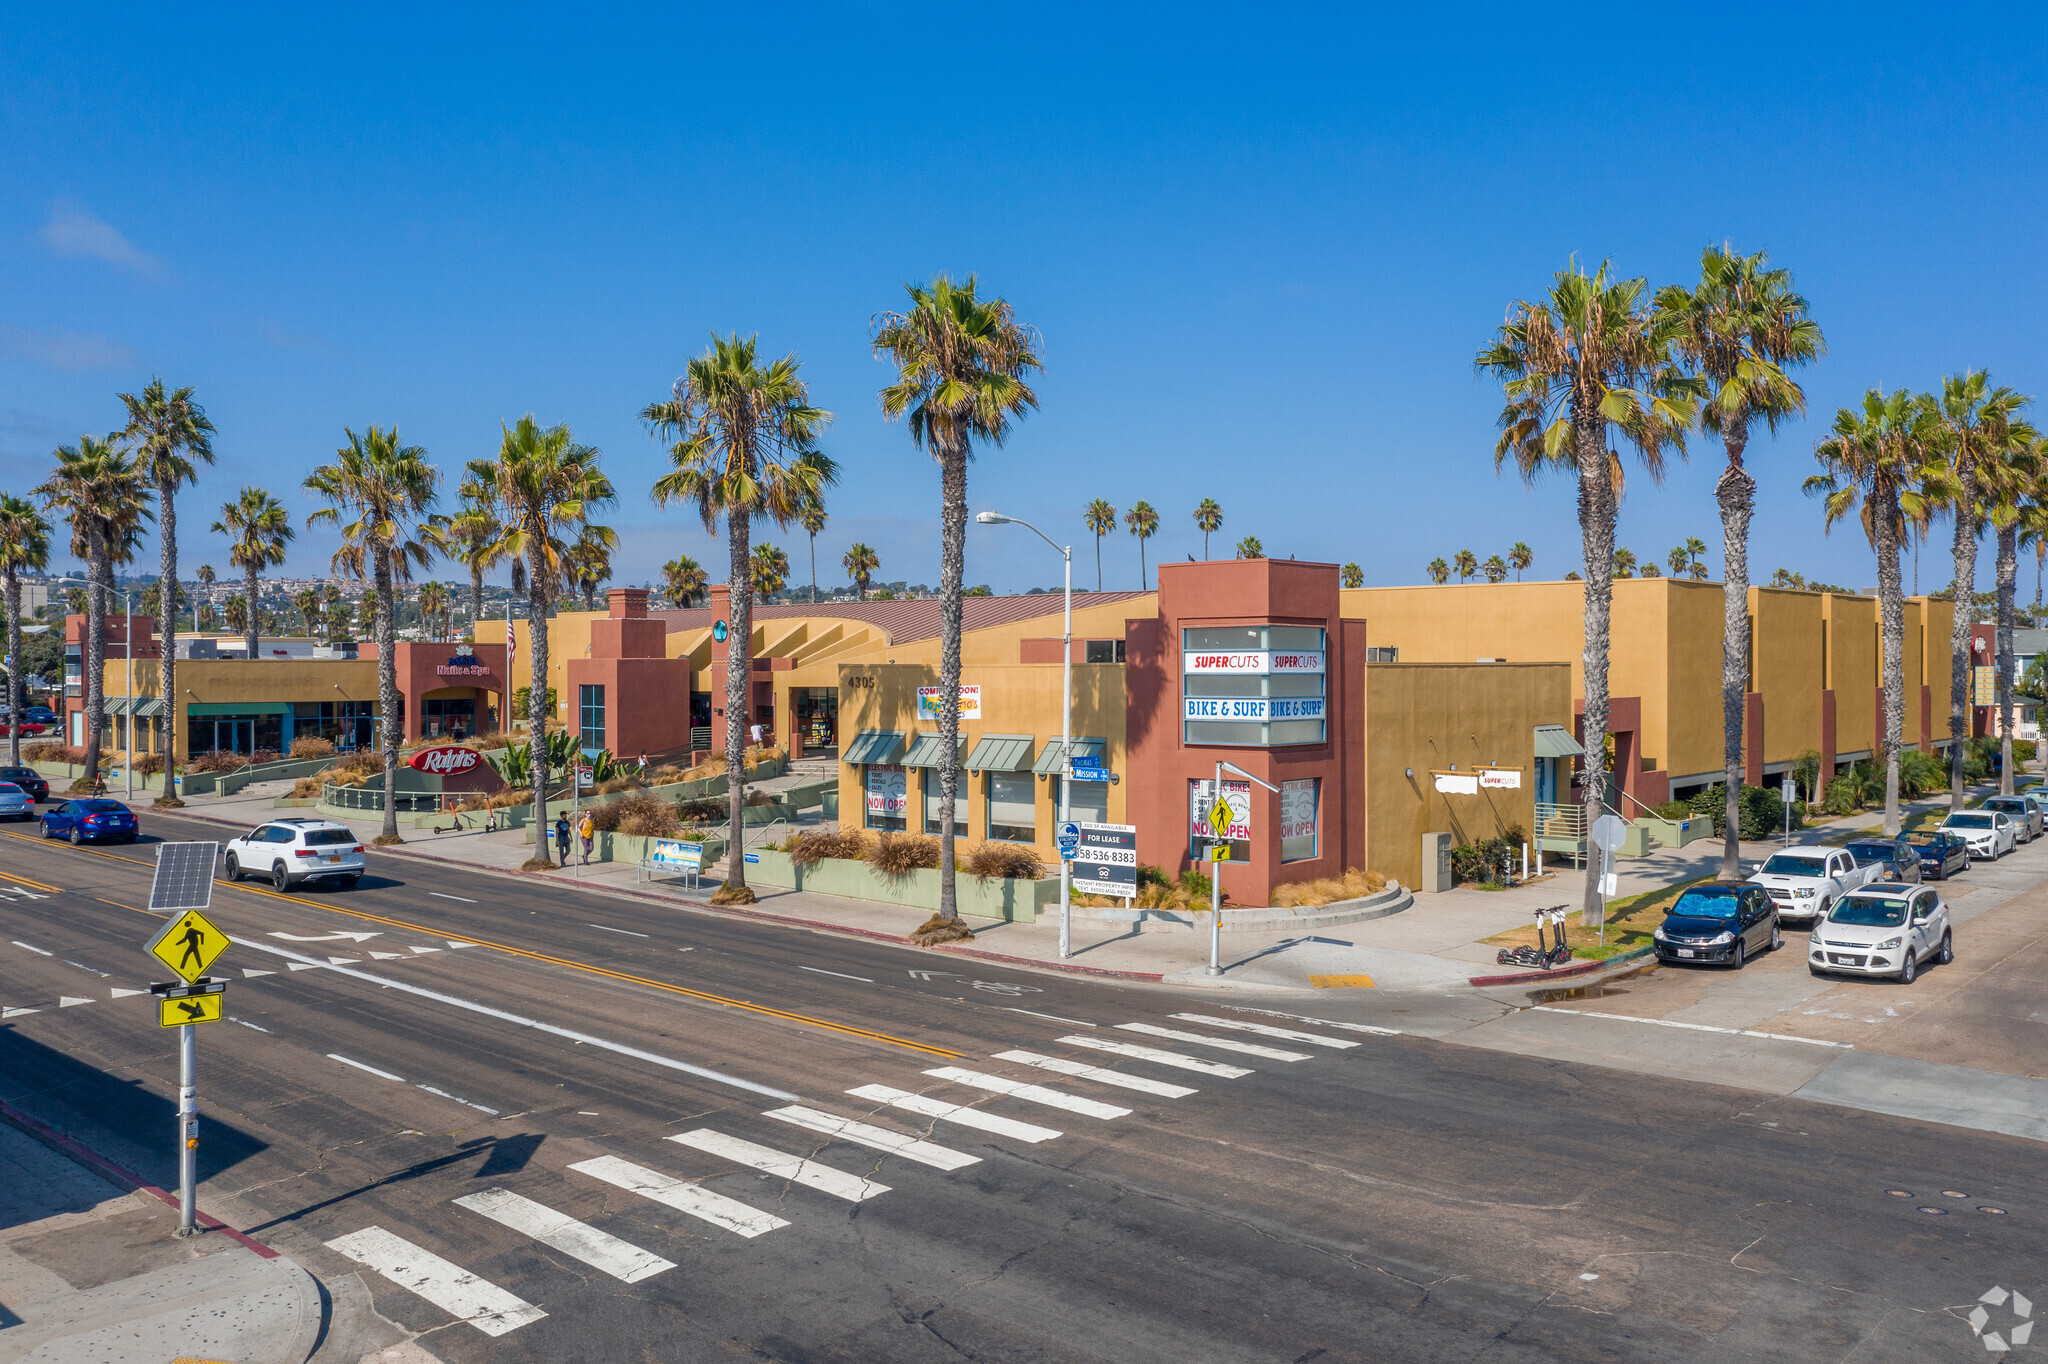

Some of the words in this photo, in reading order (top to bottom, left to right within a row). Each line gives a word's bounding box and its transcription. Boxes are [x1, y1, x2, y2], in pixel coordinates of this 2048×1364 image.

[448, 656, 479, 665] ANGEL
[1195, 655, 1259, 668] SUPERCUTS
[1274, 655, 1318, 668] SUPERCUTS
[437, 665, 463, 675] Nails
[463, 667, 470, 675] &
[470, 665, 490, 676] Spa
[848, 676, 875, 689] 4305
[918, 687, 941, 695] COMI
[958, 686, 979, 694] OON!
[1188, 701, 1218, 715] BIKE
[1221, 702, 1230, 715] &
[1233, 702, 1266, 717] SURF
[1270, 701, 1291, 717] BIKE
[1292, 702, 1299, 716] &
[1300, 700, 1322, 716] SURF
[422, 749, 477, 773] Ralphs
[1074, 759, 1093, 767] THOMAS
[894, 764, 907, 772] BIKE
[1075, 769, 1098, 778] MISSION
[1229, 783, 1250, 793] BIKES
[1280, 782, 1300, 791] ECTRIC
[868, 798, 886, 810] NOW
[1193, 821, 1210, 836] NO
[1281, 824, 1294, 838] OW
[1295, 821, 1315, 836] OPEN
[1087, 834, 1100, 842] FOR
[1101, 836, 1120, 844] LEASE
